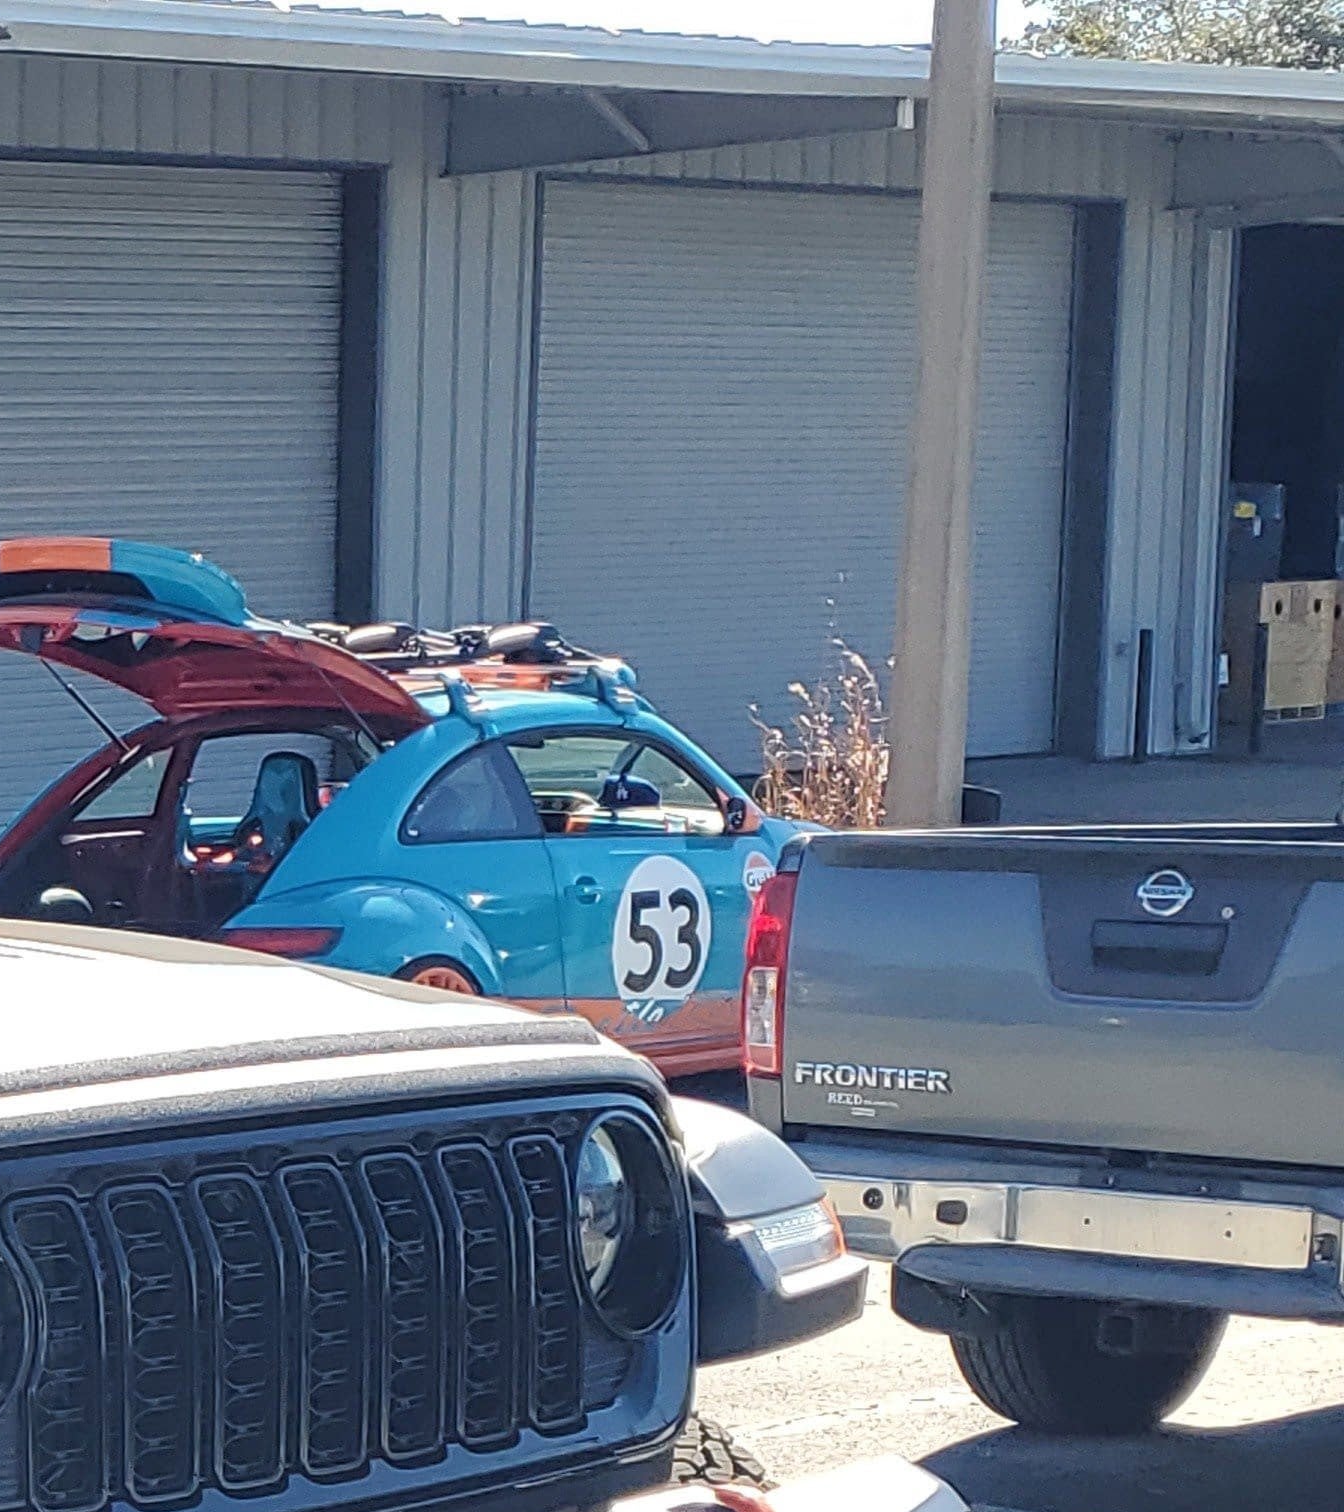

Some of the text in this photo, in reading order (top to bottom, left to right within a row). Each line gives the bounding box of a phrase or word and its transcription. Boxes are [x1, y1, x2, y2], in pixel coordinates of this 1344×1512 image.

[624, 887, 702, 993] 53
[794, 1061, 953, 1094] FRONTIER
[827, 1092, 863, 1106] REED
